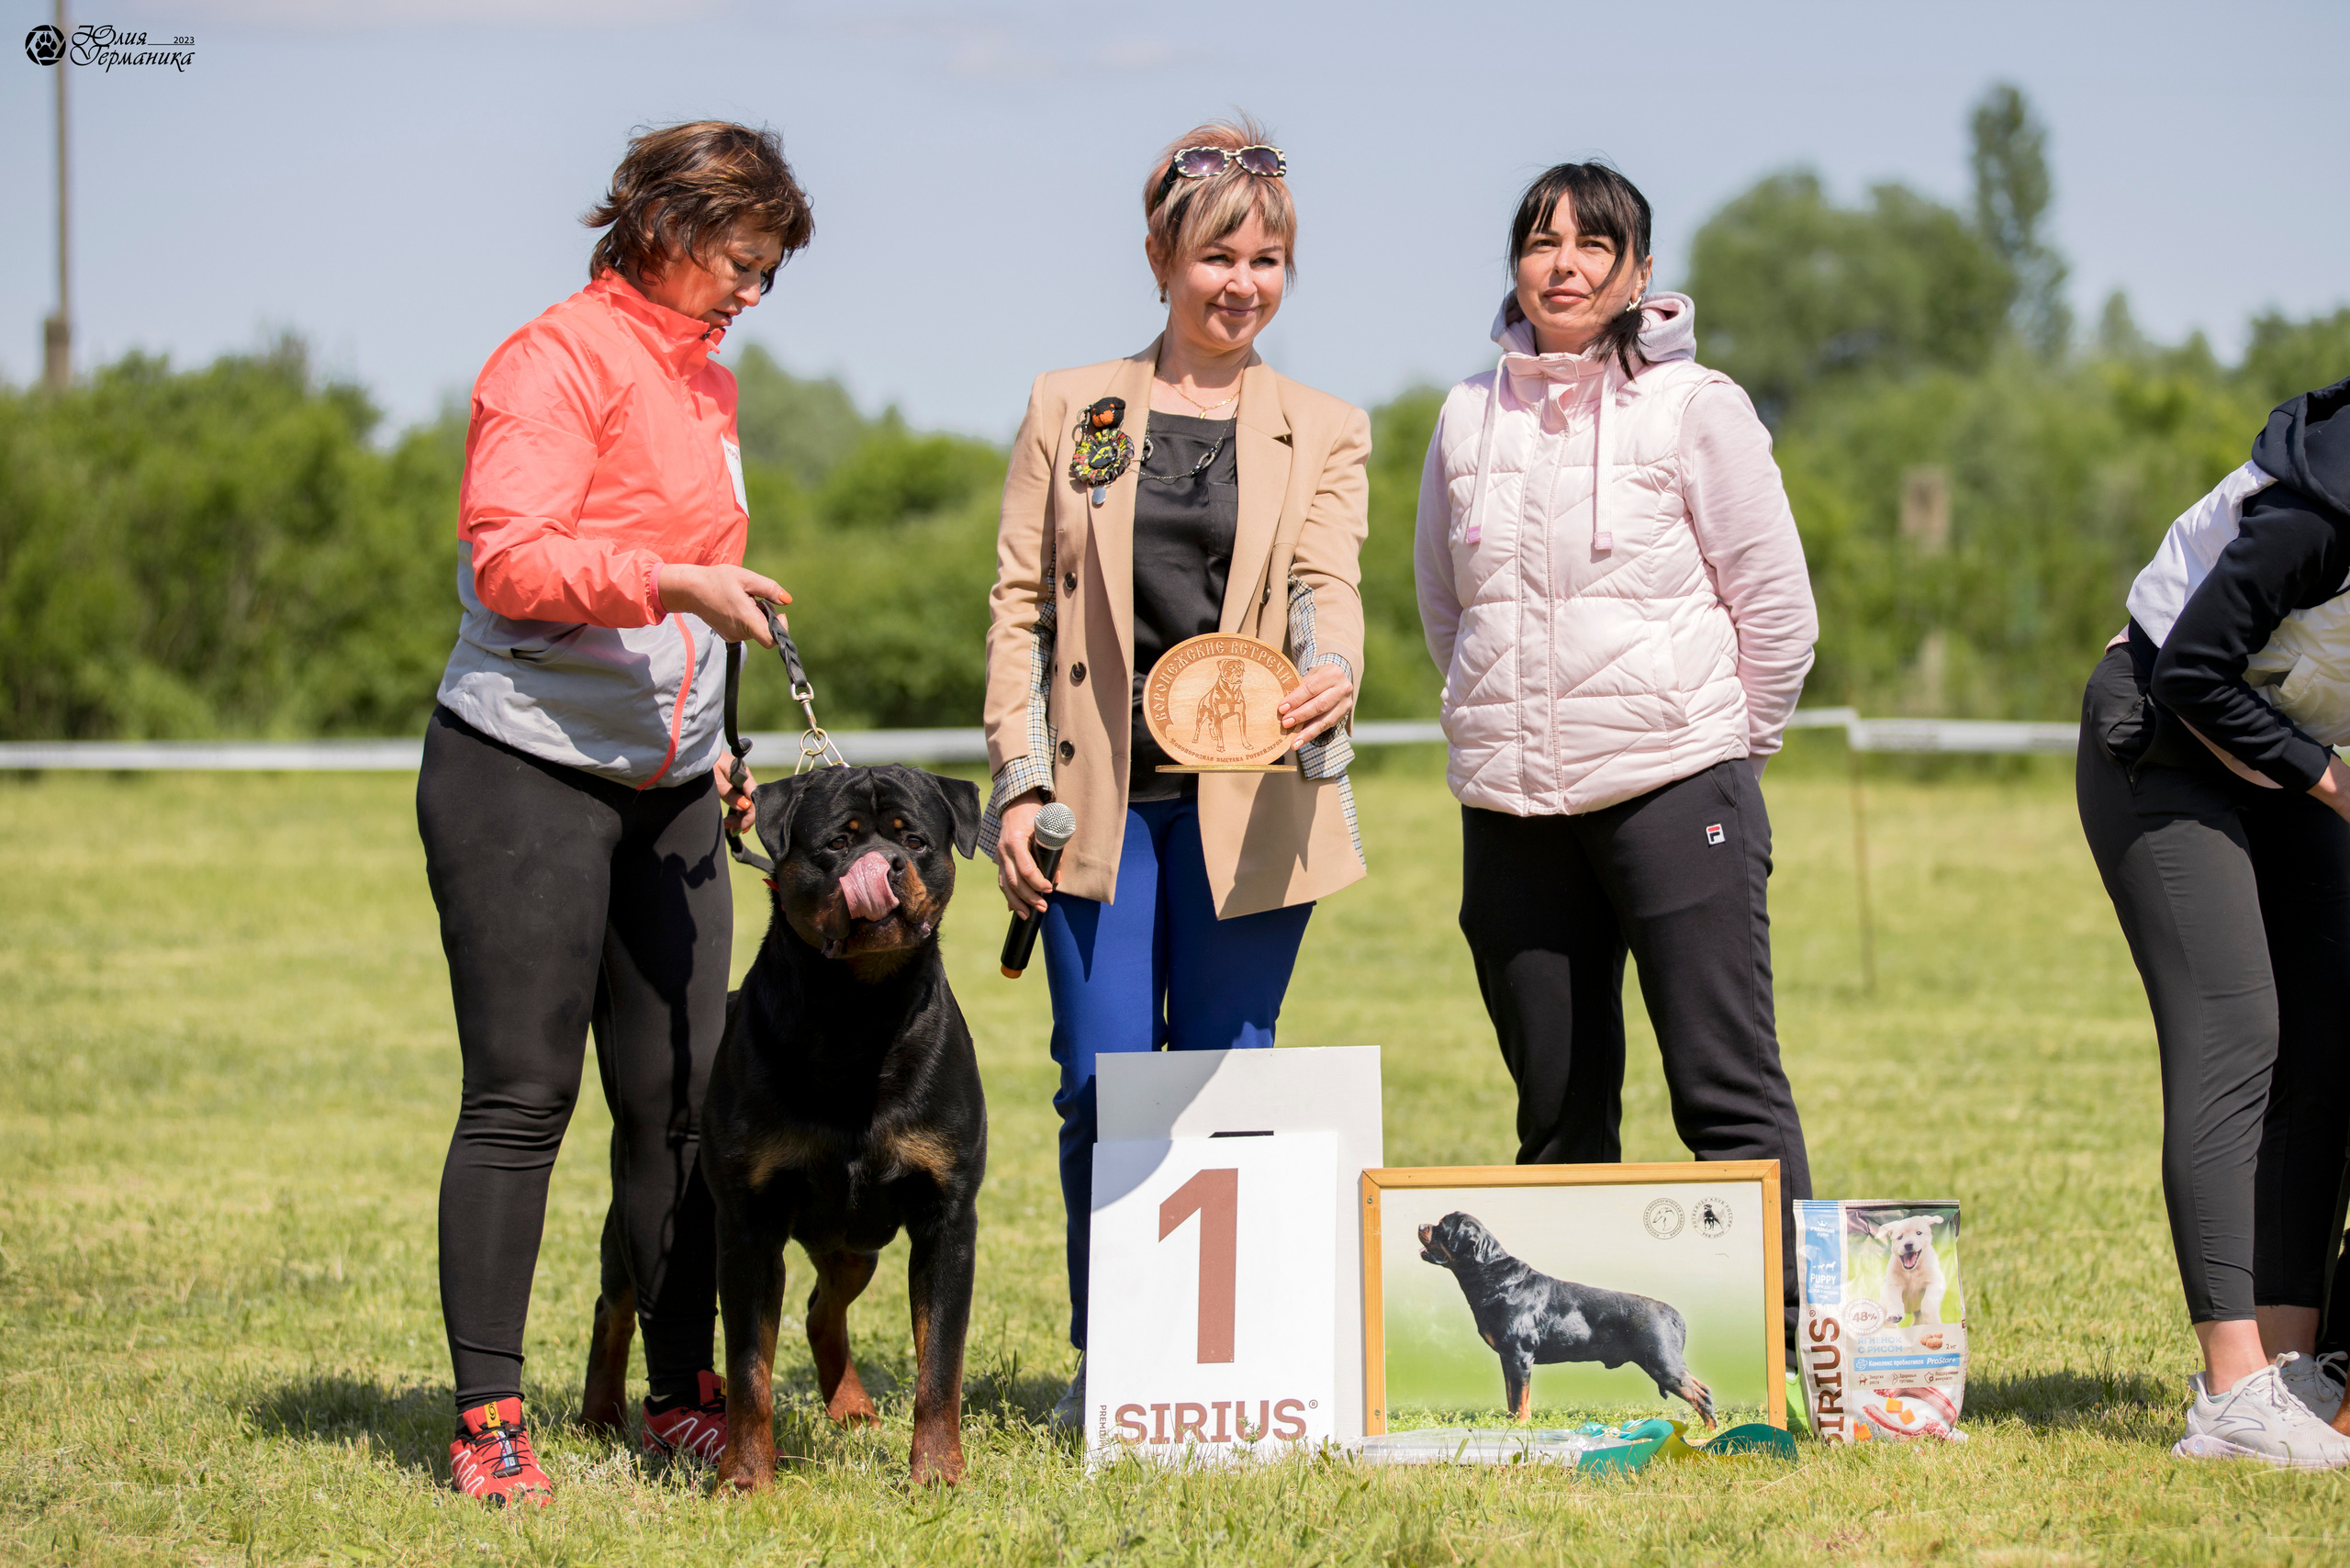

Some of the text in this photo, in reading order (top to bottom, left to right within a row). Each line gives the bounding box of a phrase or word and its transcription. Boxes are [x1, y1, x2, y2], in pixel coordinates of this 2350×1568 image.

[1229, 641, 1292, 684] ВСТРЕЧИ
[1158, 1168, 1238, 1364] 1
[1810, 1273, 1836, 1285] PUPPY
[1852, 1311, 1877, 1322] 48%
[1867, 1345, 1903, 1353] РИСОМ
